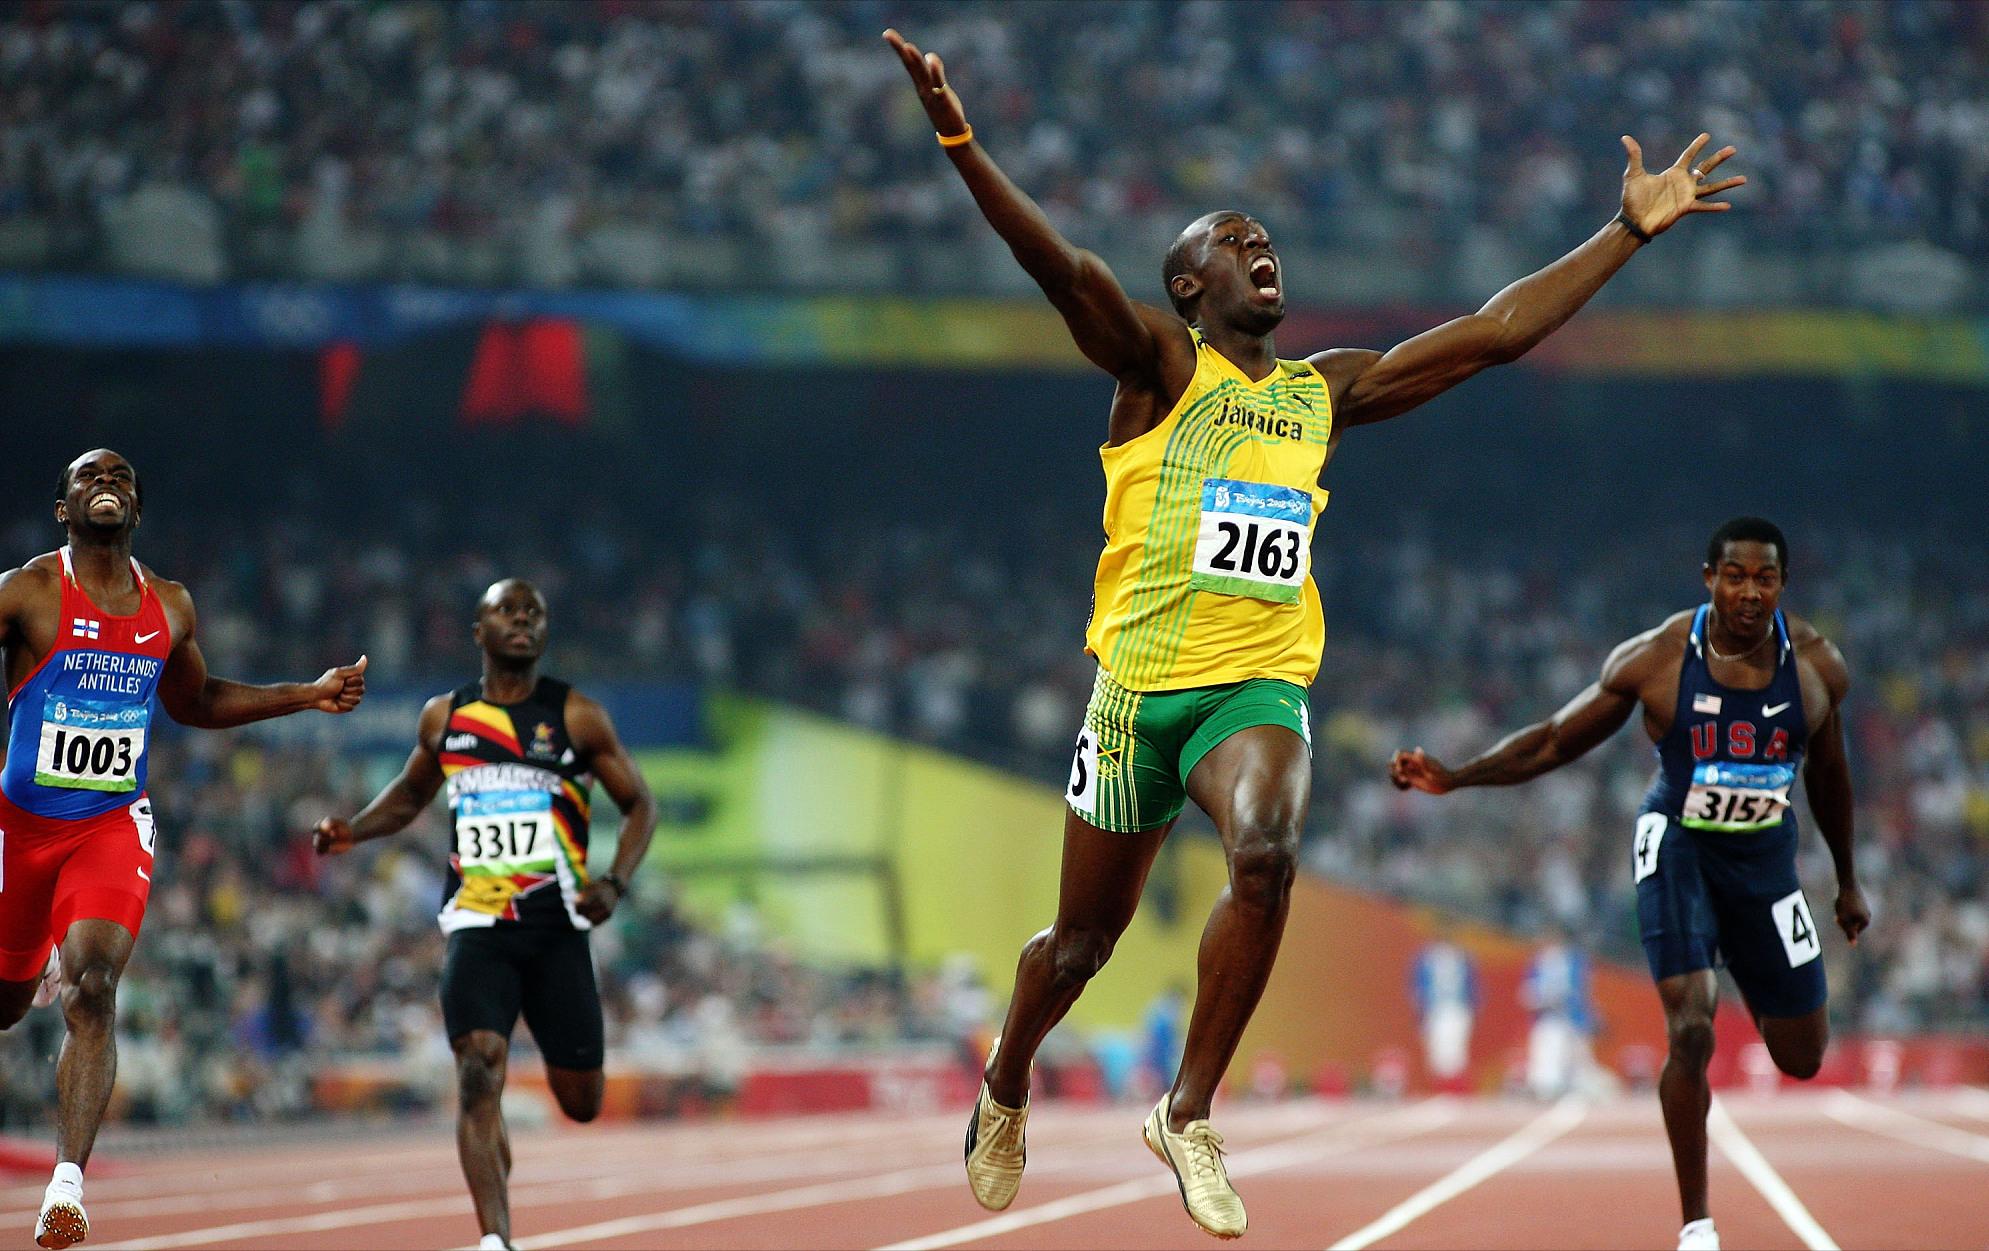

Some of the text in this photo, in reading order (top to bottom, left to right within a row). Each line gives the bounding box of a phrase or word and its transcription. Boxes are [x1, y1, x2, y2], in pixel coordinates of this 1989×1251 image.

[1209, 521, 1300, 580] 2163
[63, 652, 158, 679] NETHERLANDS
[77, 673, 141, 695] ANTILLES
[52, 730, 132, 776] 1003
[1690, 721, 1790, 761] USA
[1071, 735, 1089, 797] 5
[467, 821, 538, 859] 3317
[1638, 826, 1652, 866] 4
[1791, 903, 1815, 950] 4
